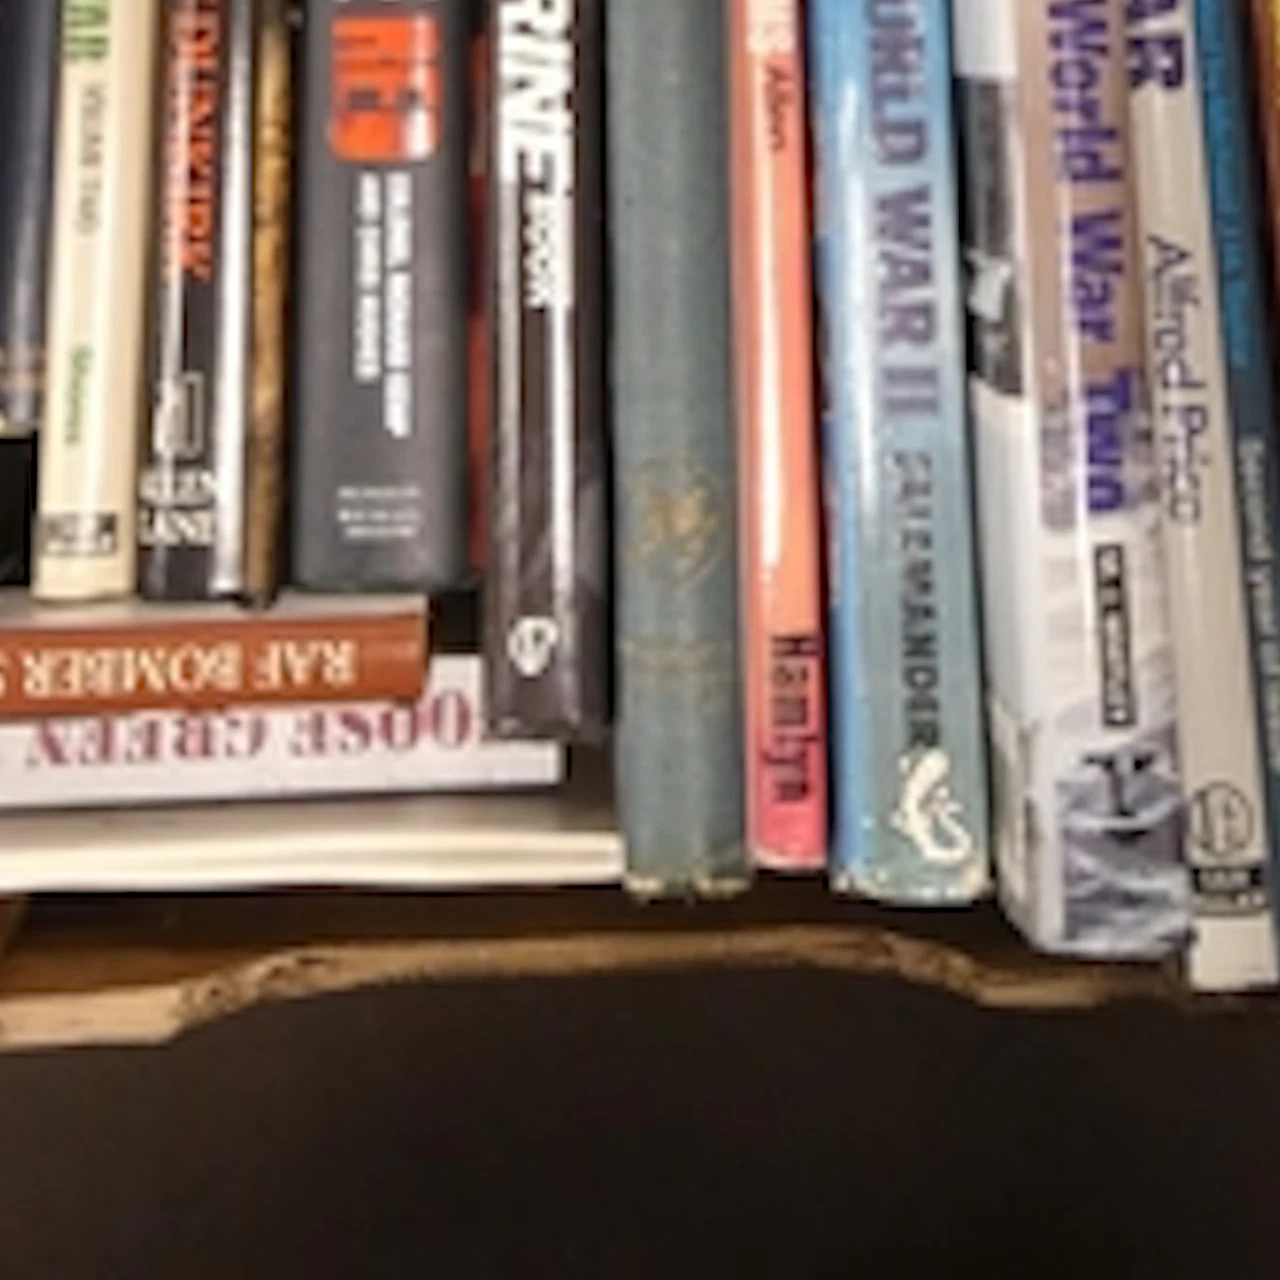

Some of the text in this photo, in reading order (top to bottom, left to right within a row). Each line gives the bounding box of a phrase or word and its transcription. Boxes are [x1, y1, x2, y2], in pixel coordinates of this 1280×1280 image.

[325, 15, 437, 163] RED
[871, 185, 935, 338] WAR
[1057, 208, 1130, 346] War
[877, 358, 937, 423] II
[1077, 366, 1140, 516] Two
[1144, 230, 1215, 524] Alfred Price
[21, 633, 242, 709] BOMBER
[257, 634, 355, 692] RAF
[890, 451, 944, 749] SALAMANDER
[24, 689, 473, 774] OOSE GREEN
[757, 630, 821, 807] Hamlyn
